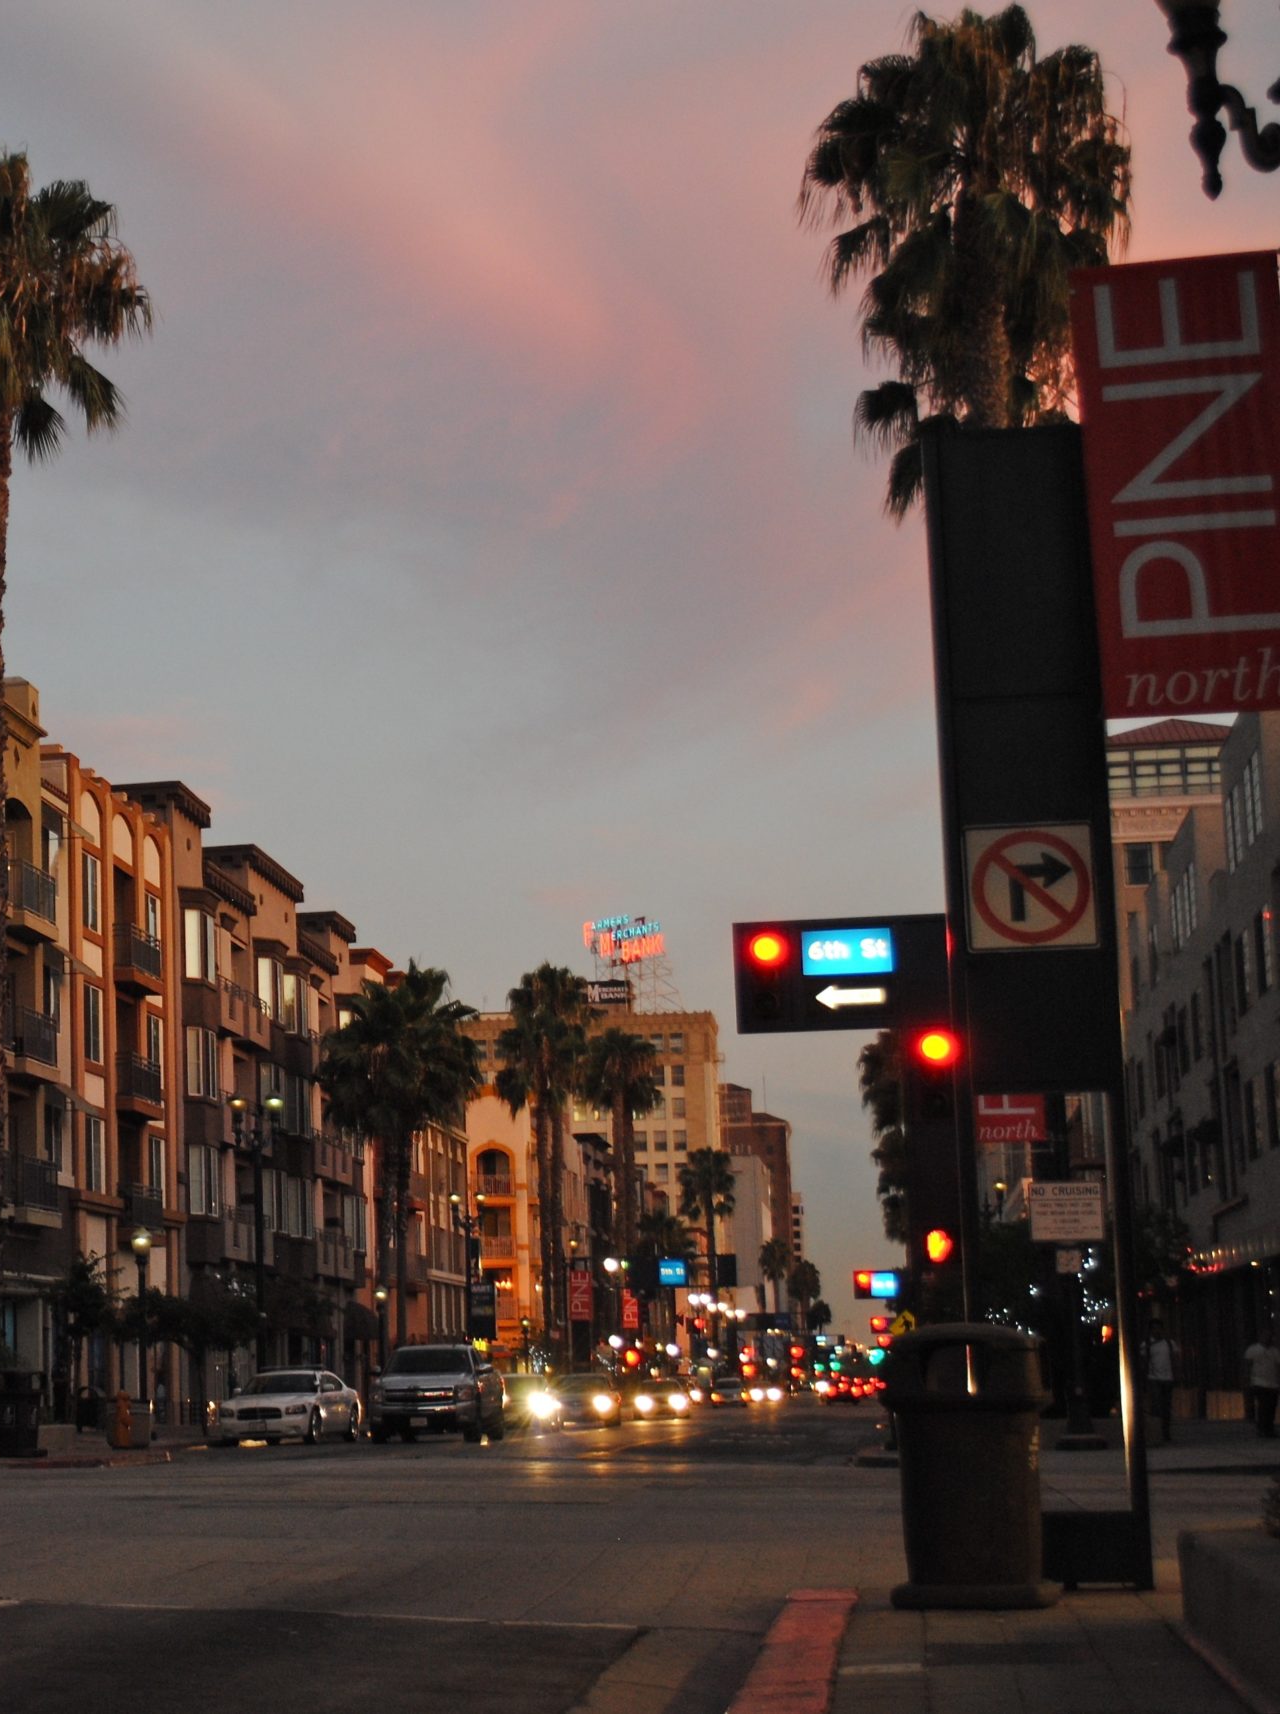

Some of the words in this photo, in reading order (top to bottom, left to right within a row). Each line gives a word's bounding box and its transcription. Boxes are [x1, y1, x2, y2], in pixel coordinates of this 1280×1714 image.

[1093, 270, 1280, 640] PINE
[1124, 646, 1280, 708] north
[621, 933, 664, 962] BANK
[808, 940, 849, 960] 6th
[860, 938, 886, 958] St
[979, 1119, 1038, 1140] north
[1031, 1186, 1045, 1197] NO
[1051, 1185, 1099, 1197] CRUISING
[571, 1271, 589, 1312] PINE
